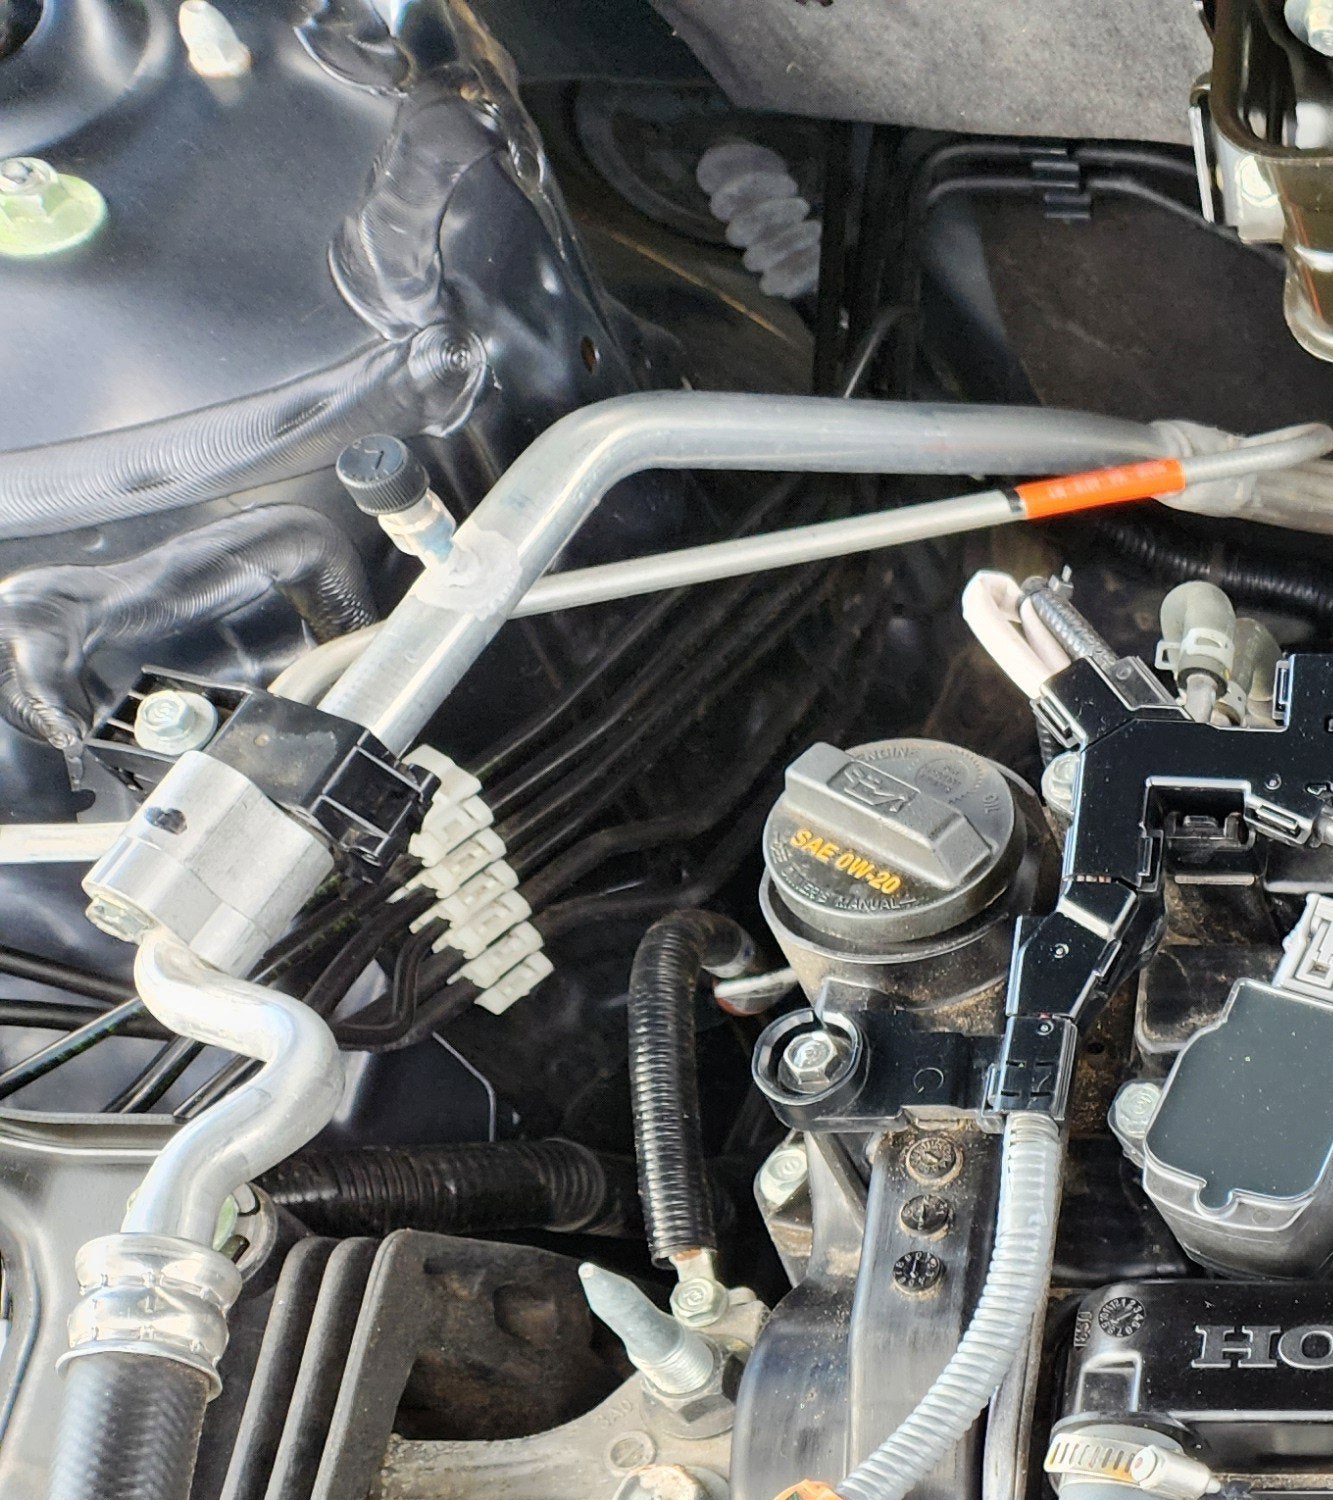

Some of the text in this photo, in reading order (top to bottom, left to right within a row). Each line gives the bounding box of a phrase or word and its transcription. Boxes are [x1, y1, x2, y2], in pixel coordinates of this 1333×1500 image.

[790, 828, 903, 896] SAE 0W-20
[834, 895, 899, 911] MANUAL
